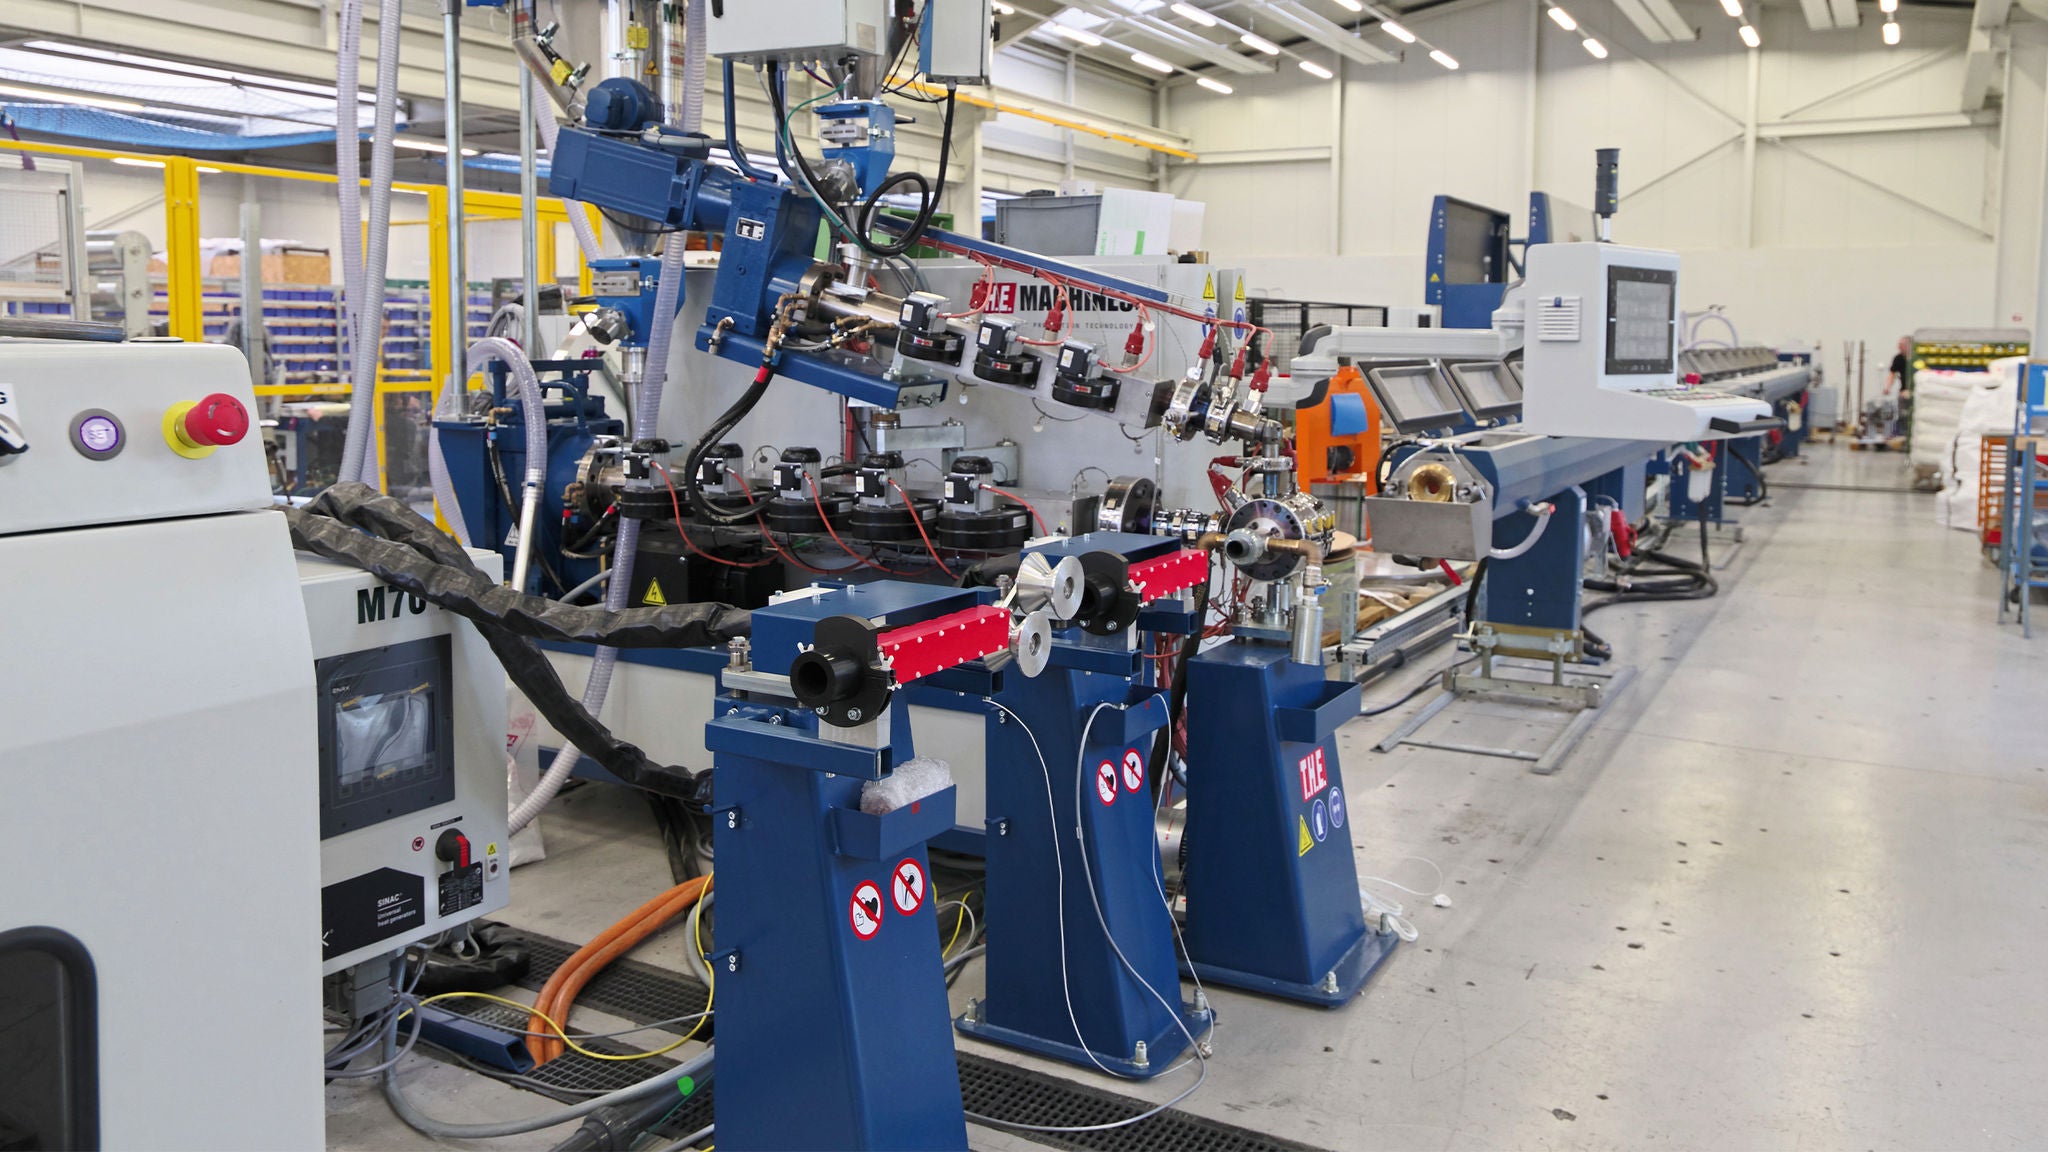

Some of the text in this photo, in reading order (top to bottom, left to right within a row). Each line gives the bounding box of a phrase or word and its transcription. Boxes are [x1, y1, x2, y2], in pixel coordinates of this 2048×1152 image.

[974, 285, 1013, 312] H.E.
[377, 906, 402, 920] Universal
[390, 909, 417, 925] generators
